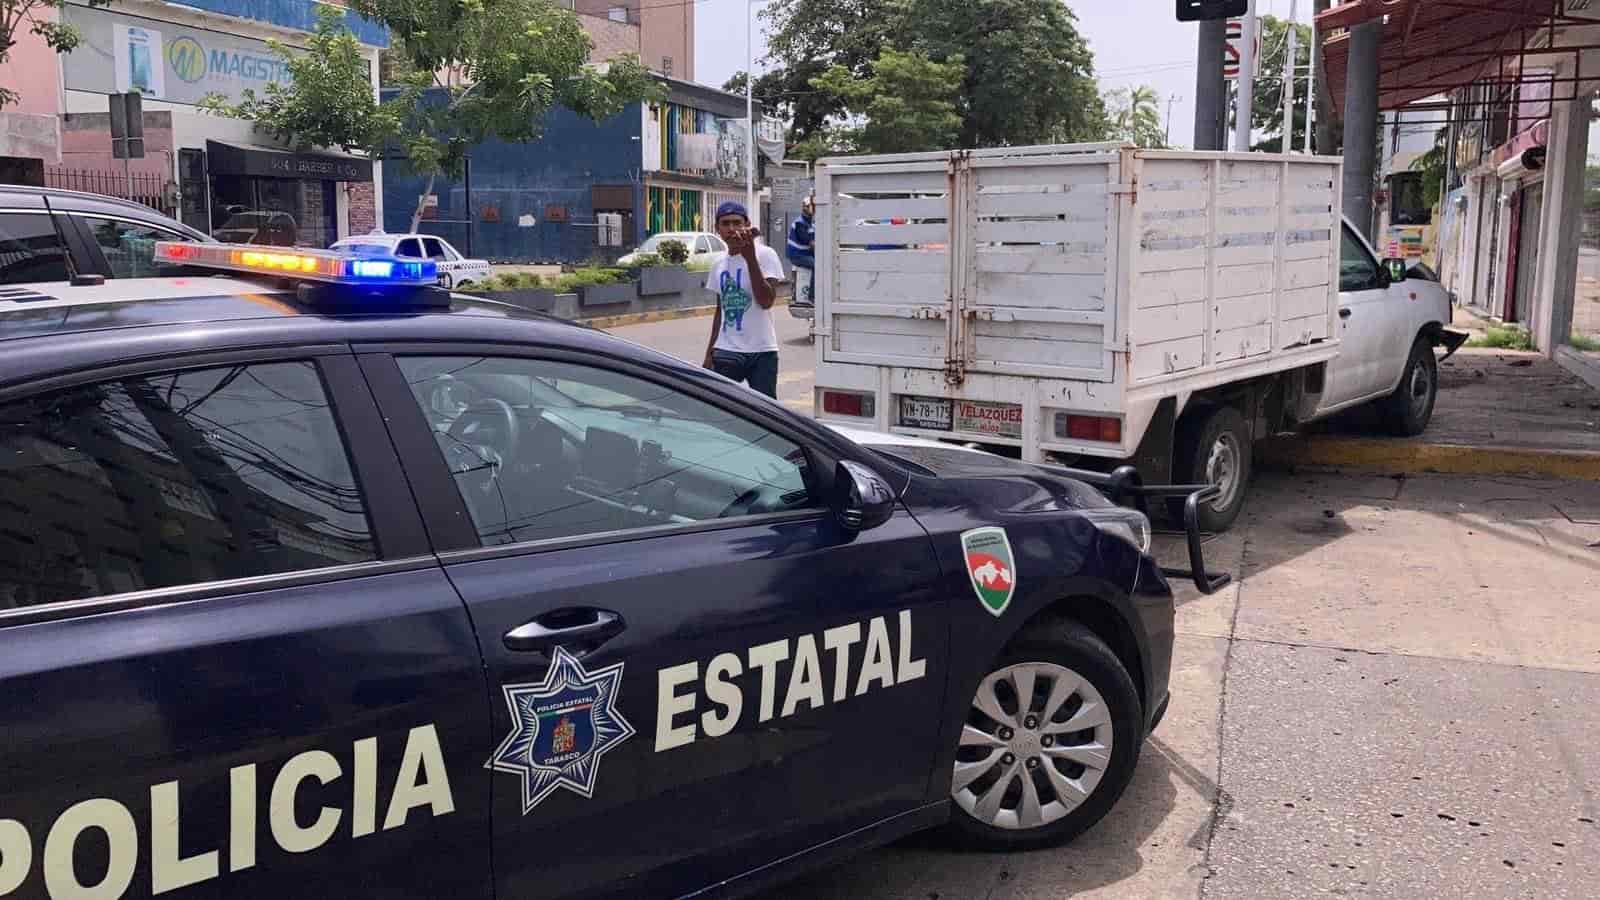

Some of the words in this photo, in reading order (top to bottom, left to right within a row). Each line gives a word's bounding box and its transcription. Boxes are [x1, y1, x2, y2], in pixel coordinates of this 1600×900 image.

[959, 403, 1022, 422] VELAZQUEZ
[655, 609, 926, 752] ESTATAL
[537, 703, 564, 712] POLICIA
[565, 696, 593, 706] ESTATAL
[544, 751, 580, 764] TABASCO
[0, 723, 455, 900] POLICIA
